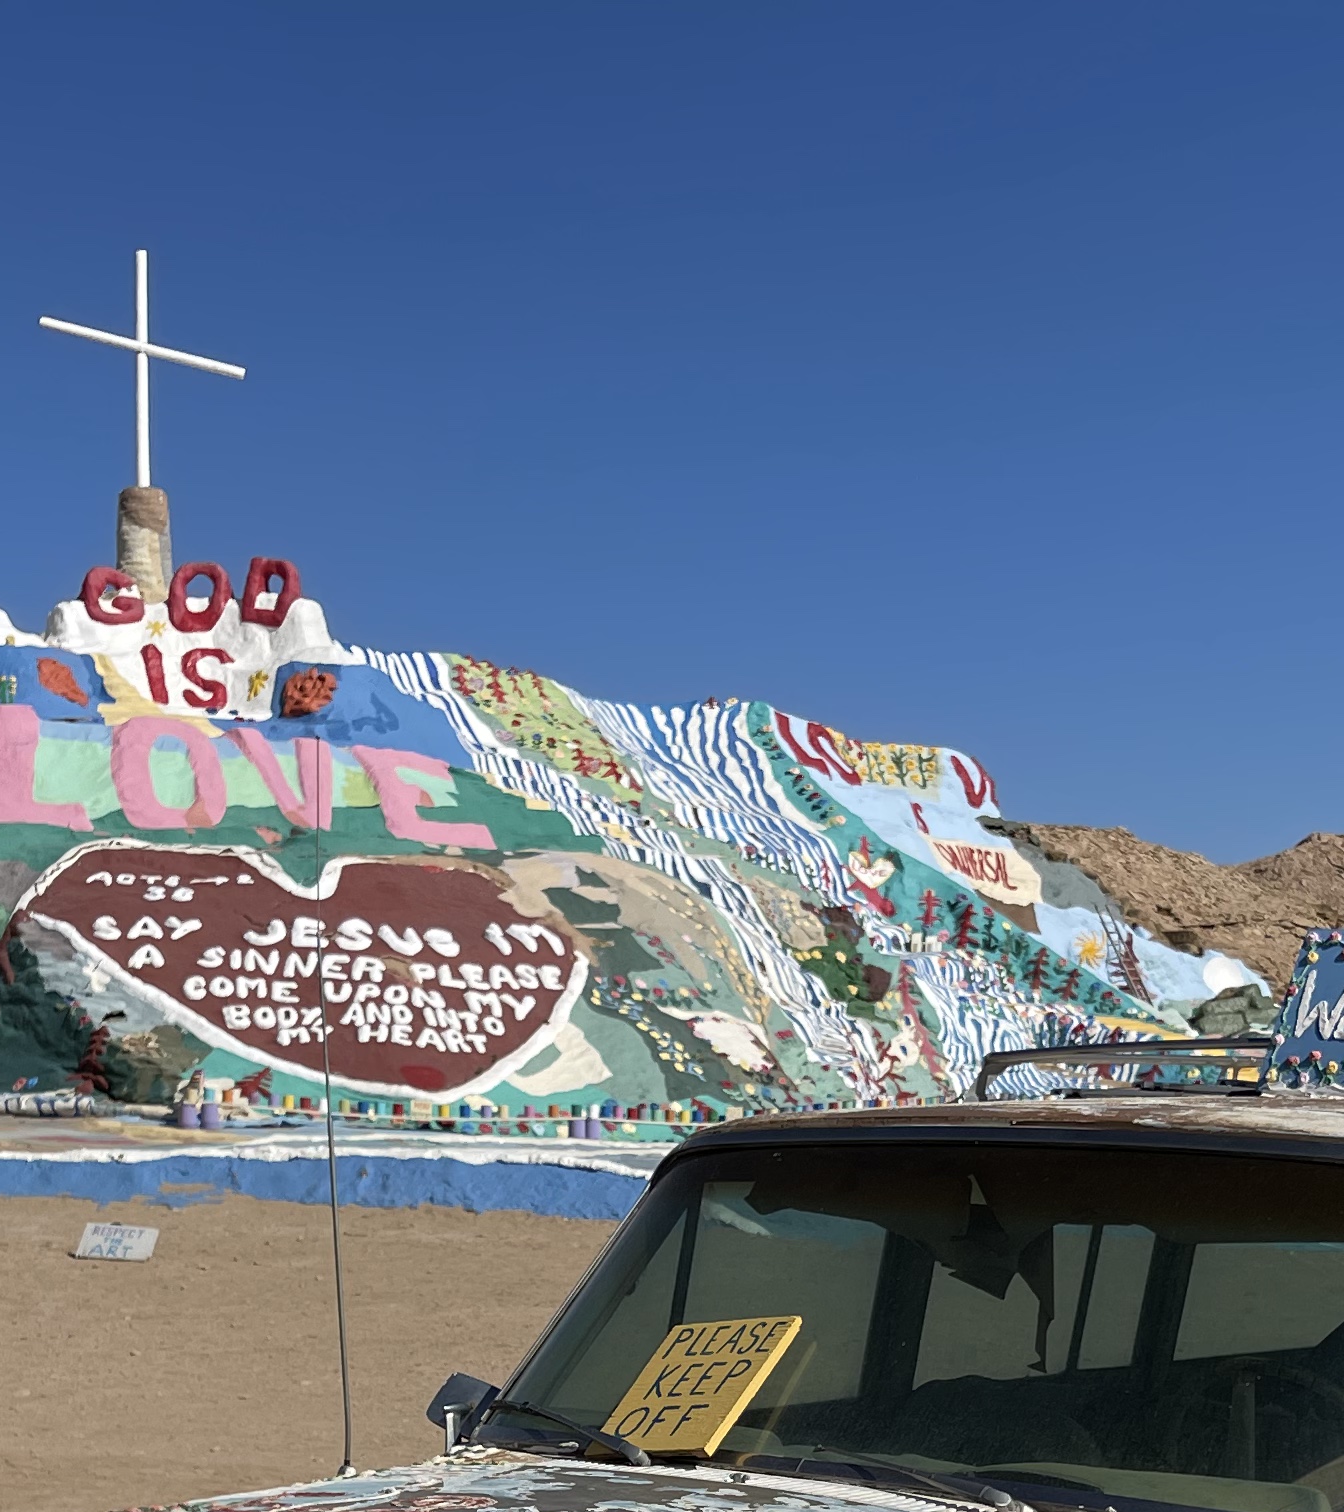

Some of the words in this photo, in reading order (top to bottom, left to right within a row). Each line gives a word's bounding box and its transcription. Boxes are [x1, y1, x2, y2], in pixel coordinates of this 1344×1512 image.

[79, 556, 302, 633] GOD
[140, 643, 235, 709] IS
[92, 915, 203, 941] SAY
[243, 916, 461, 958] JESUS
[127, 943, 165, 970] A
[197, 945, 386, 984] SINNER
[408, 961, 565, 990] PLEASE
[182, 974, 301, 1004] COME
[323, 980, 447, 1010] UPON
[463, 990, 537, 1021] MY
[276, 1023, 335, 1047] MY
[357, 1024, 488, 1054] HEART
[340, 1002, 414, 1027] AND
[422, 1006, 507, 1037] INTO
[87, 1243, 133, 1259] ART
[662, 1321, 790, 1360] PLEASE
[643, 1359, 753, 1400] KEEP
[613, 1403, 709, 1440] OFF
